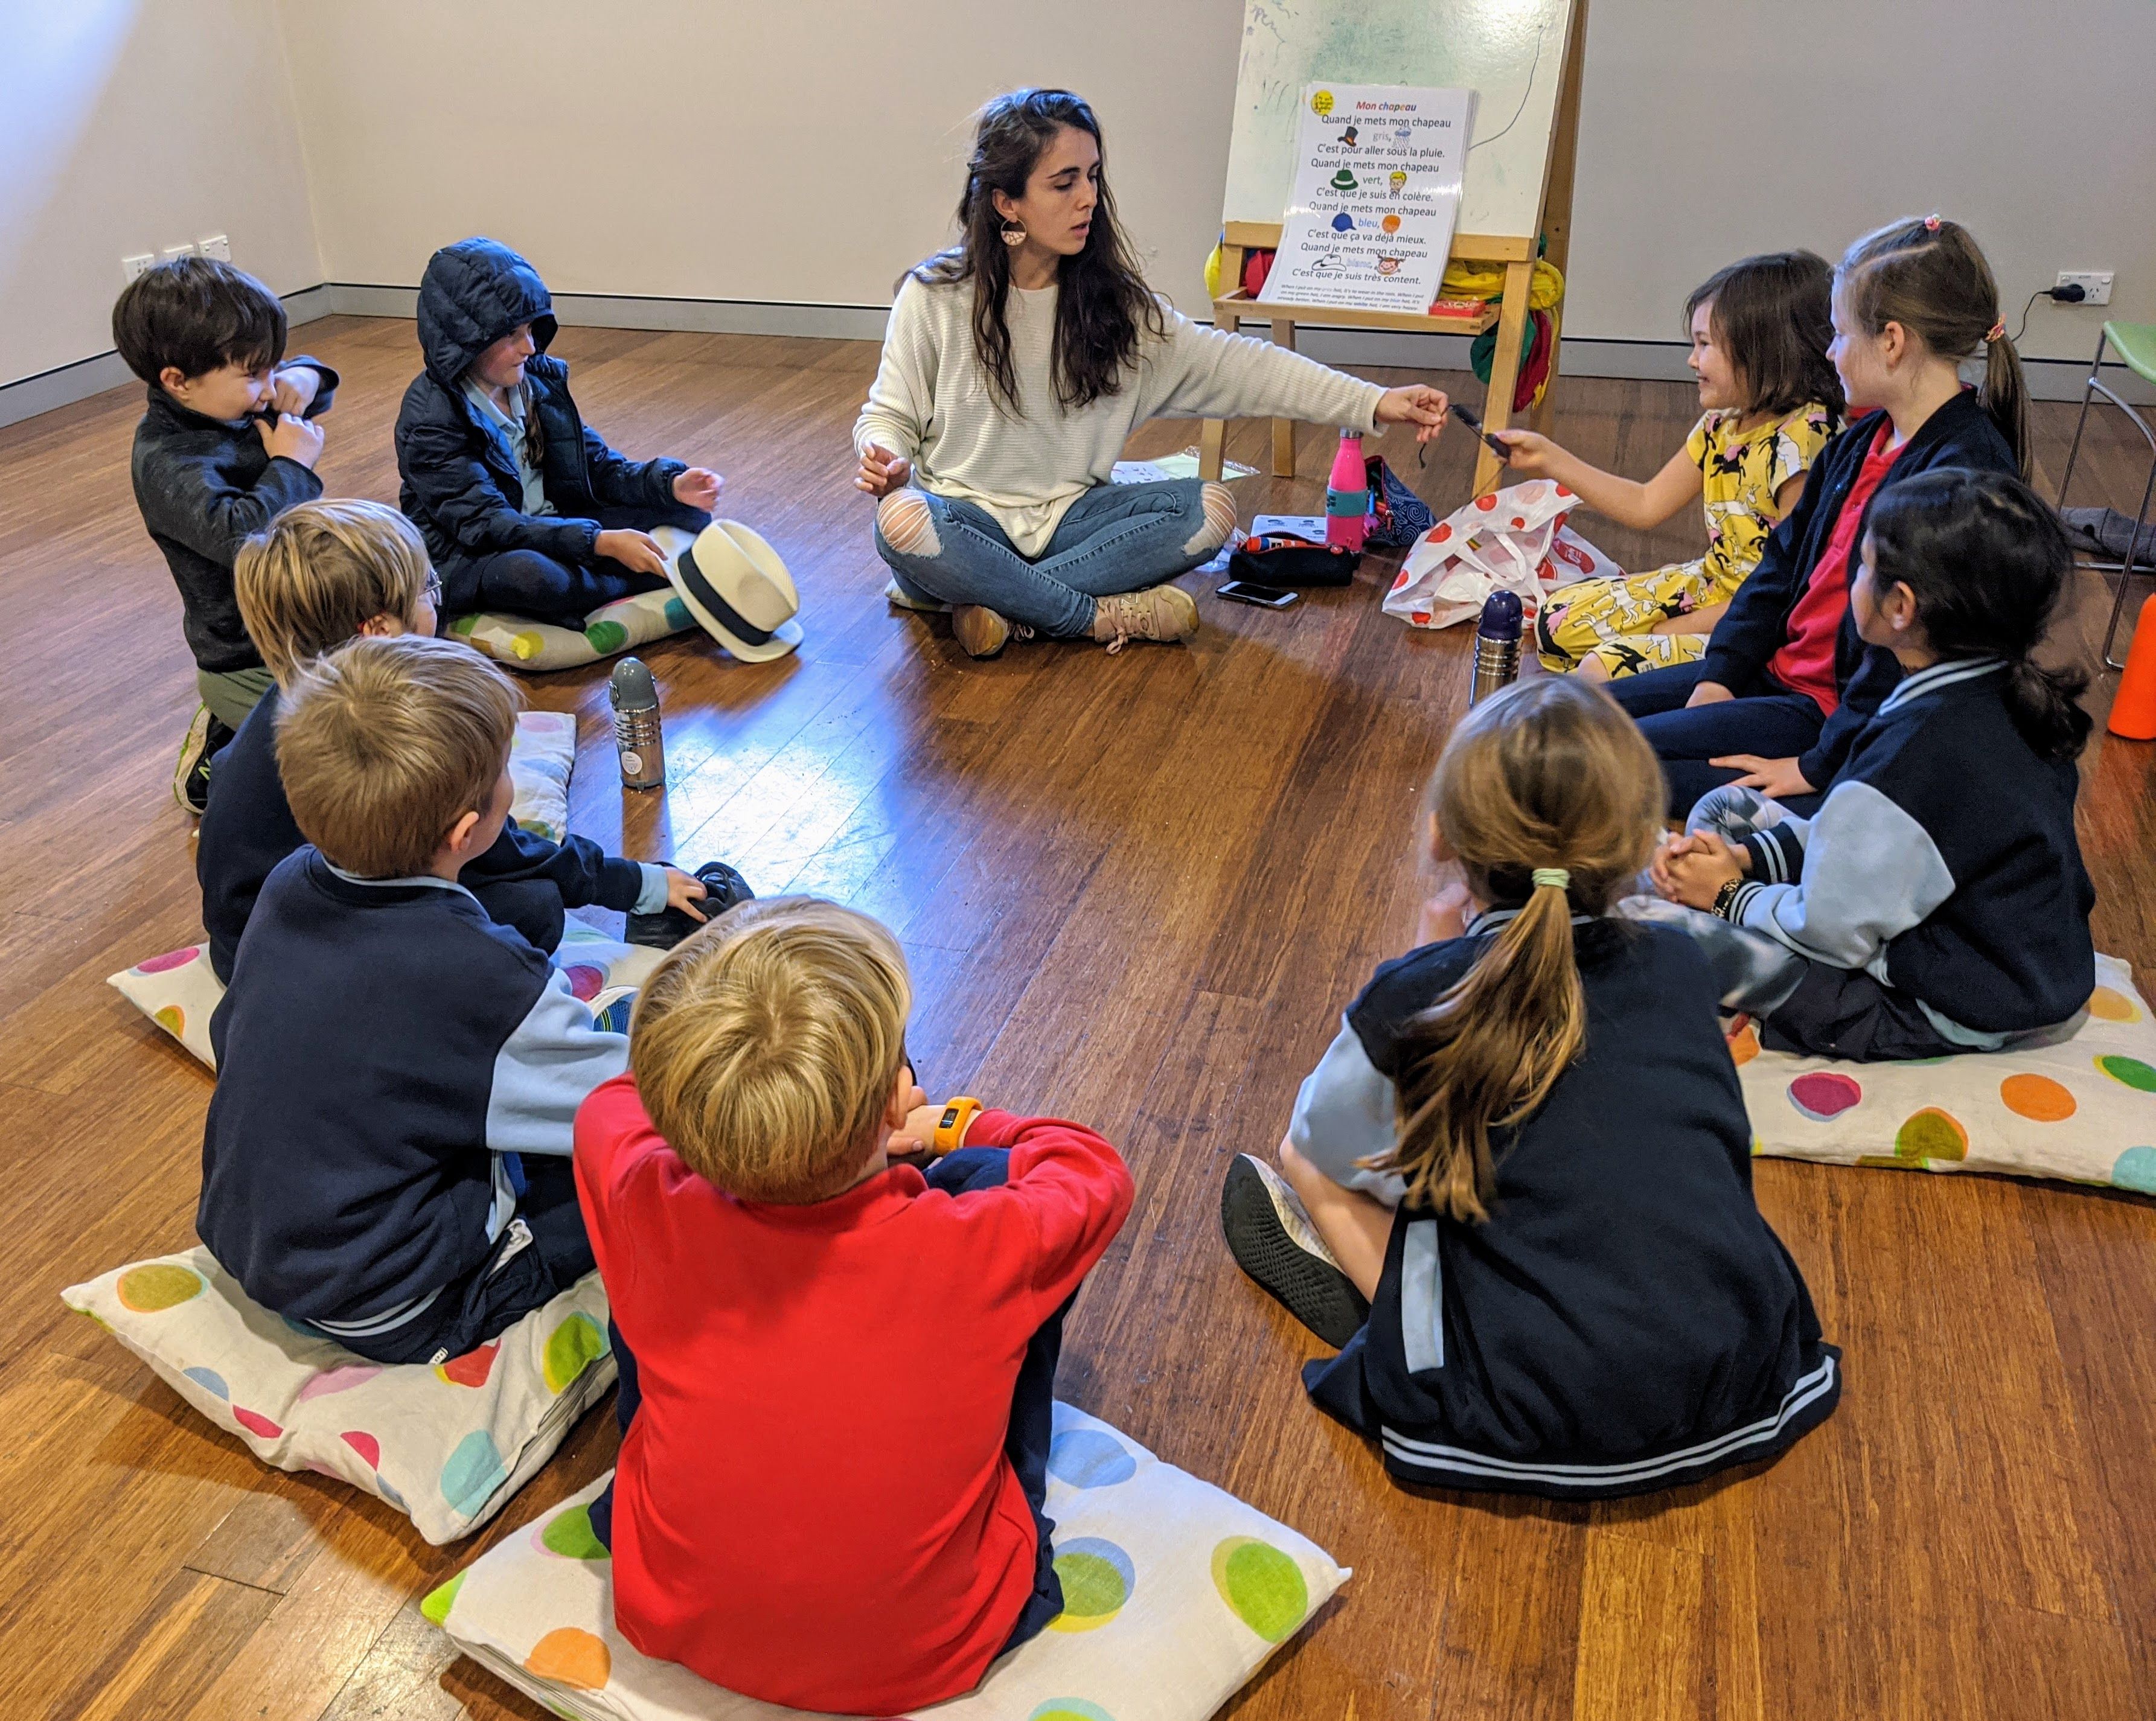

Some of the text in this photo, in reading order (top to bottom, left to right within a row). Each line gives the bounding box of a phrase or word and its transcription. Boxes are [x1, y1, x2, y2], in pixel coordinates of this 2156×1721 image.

[1356, 101, 1416, 112] Mon chapeau
[1322, 115, 1351, 124] Quand
[1353, 117, 1362, 126] je
[1364, 117, 1387, 126] mets
[1412, 117, 1451, 128] chapeau
[1373, 132, 1391, 142] gris,
[1317, 144, 1445, 159] C'est pour aller sous la pluie.
[1311, 159, 1340, 169] Quand
[1343, 161, 1351, 170] je
[1353, 161, 1375, 170] mets
[1400, 162, 1439, 173] chapeau
[1363, 176, 1383, 186] vert,
[1316, 187, 1338, 197] C'est
[1340, 191, 1357, 200] que
[1358, 190, 1367, 199] je
[1369, 190, 1386, 199] suis
[1403, 192, 1433, 202] colère.
[1309, 201, 1436, 217] Quand je mets mon chapeau
[1358, 218, 1380, 228] bleu,
[1308, 229, 1329, 239] C'est
[1331, 232, 1348, 241] que
[1350, 233, 1360, 242] ça
[1375, 232, 1393, 243] déjà
[1396, 234, 1426, 244] mieux.
[1300, 242, 1427, 258] Quand je mets mon chapeau
[1292, 268, 1421, 284] C'est que je suis très content.
